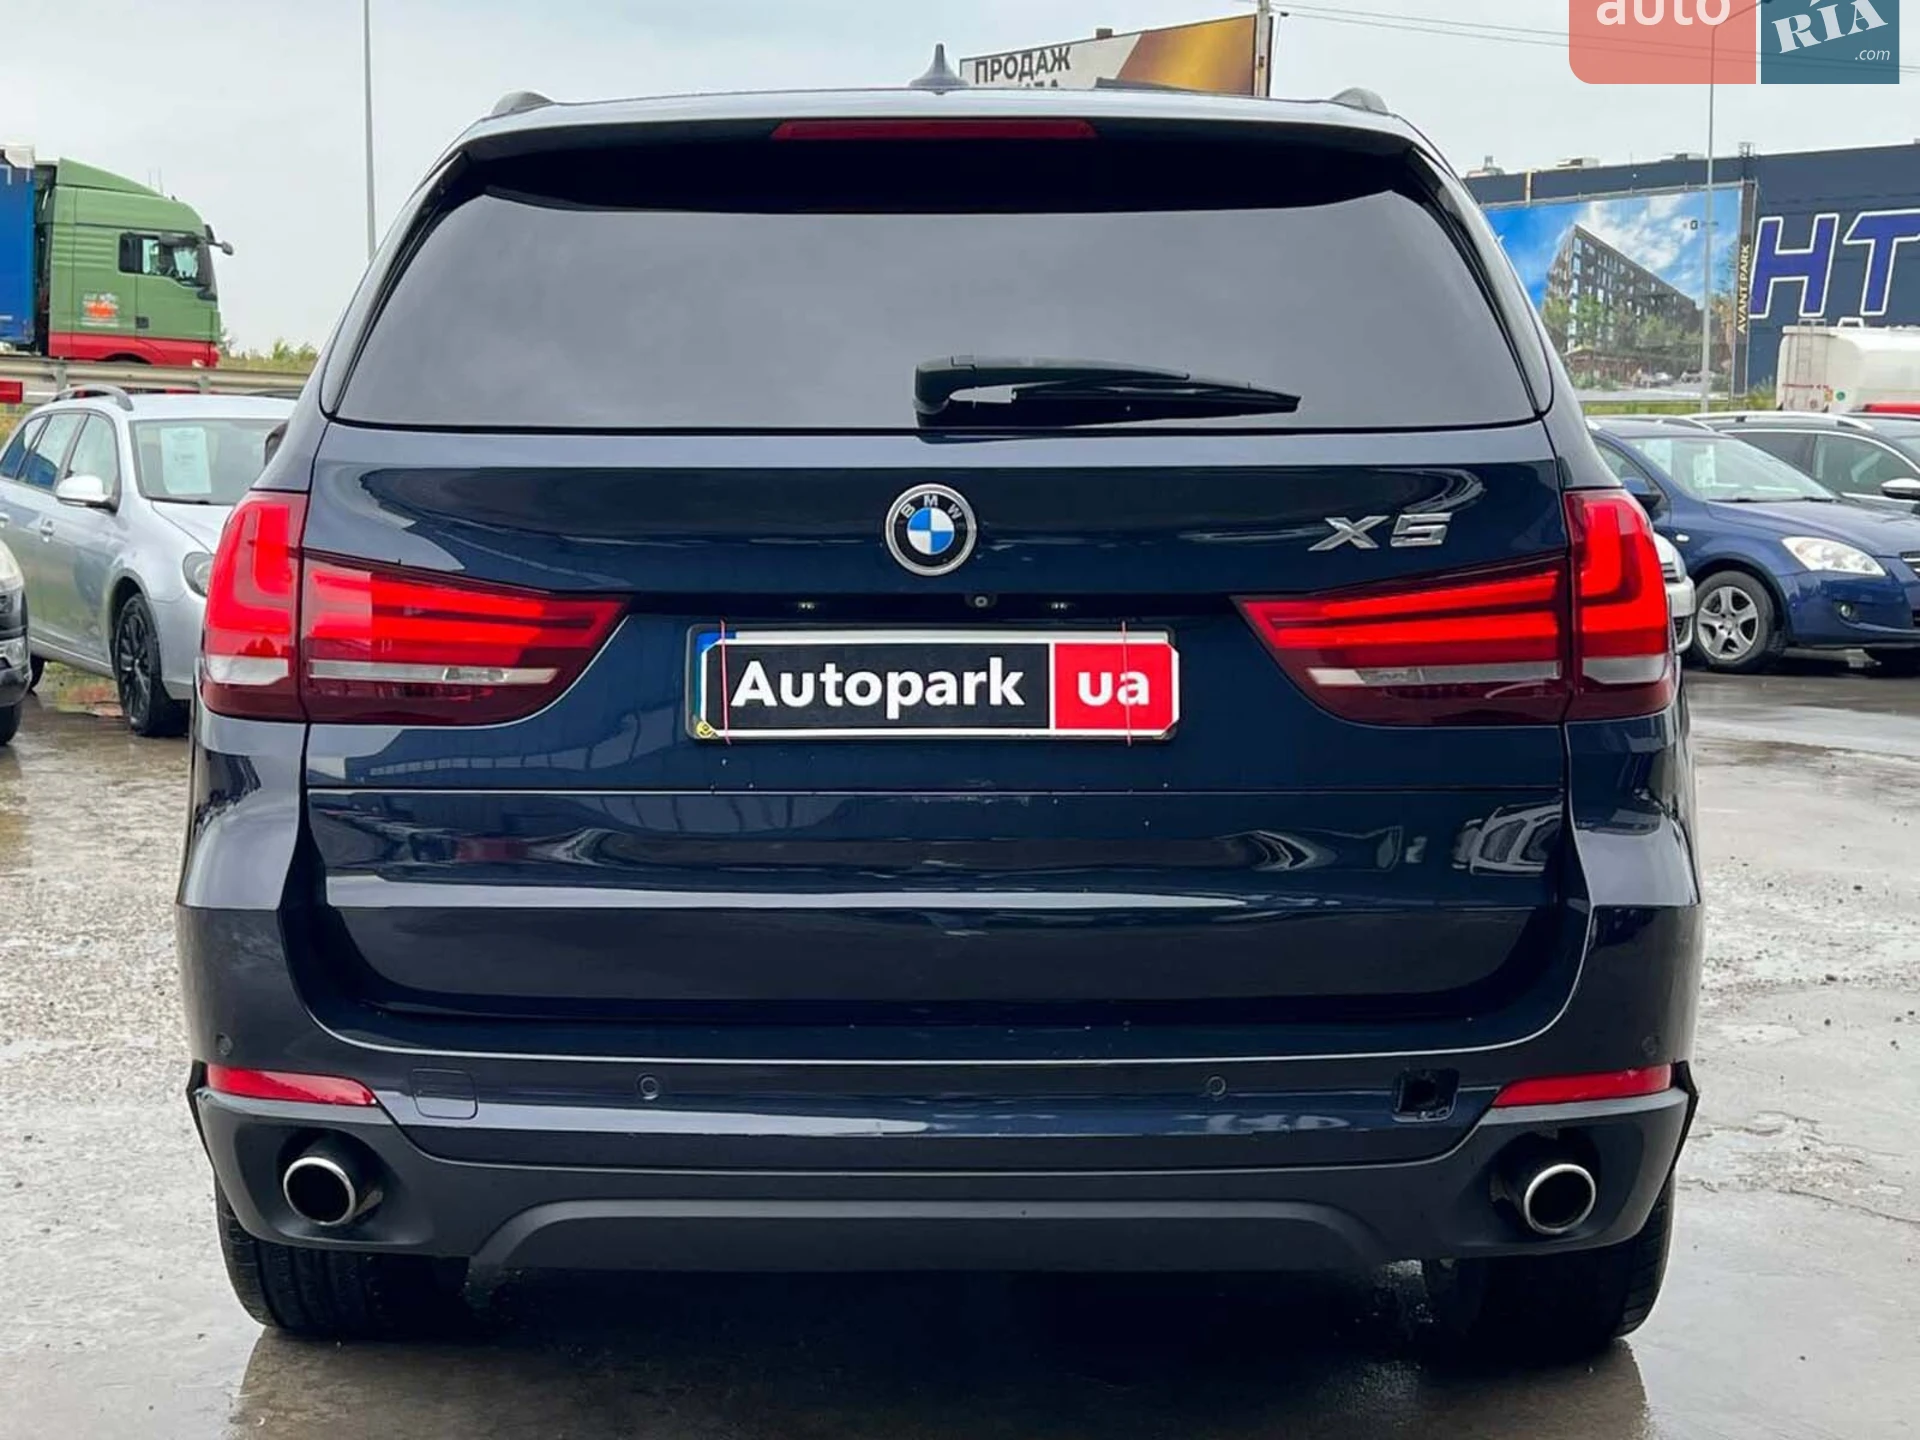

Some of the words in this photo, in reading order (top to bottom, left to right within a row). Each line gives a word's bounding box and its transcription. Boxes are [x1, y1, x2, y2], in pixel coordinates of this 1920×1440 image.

[975, 46, 1071, 84] ПРОДАЖ
[900, 494, 963, 520] BMW
[1307, 512, 1453, 551] X5
[730, 657, 1025, 719] Autopark
[1077, 671, 1150, 706] ua
